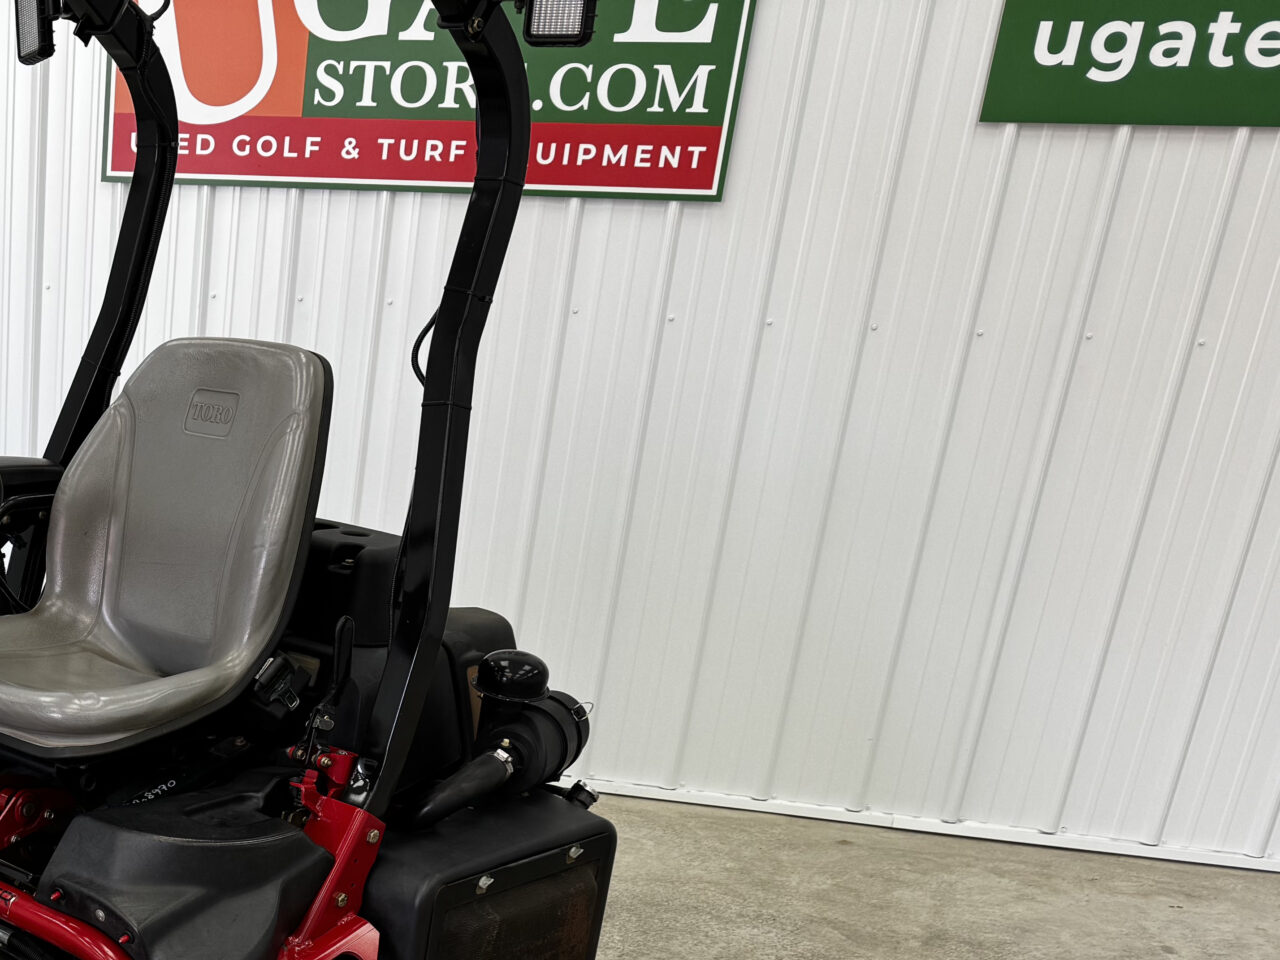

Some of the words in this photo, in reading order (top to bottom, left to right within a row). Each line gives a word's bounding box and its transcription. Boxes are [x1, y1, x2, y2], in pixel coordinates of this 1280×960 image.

[314, 60, 717, 114] STOR.COM
[232, 134, 322, 158] GOLF
[340, 137, 360, 160] &
[377, 138, 467, 163] TURF
[535, 141, 707, 169] UIPMENT
[192, 402, 234, 425] TORO
